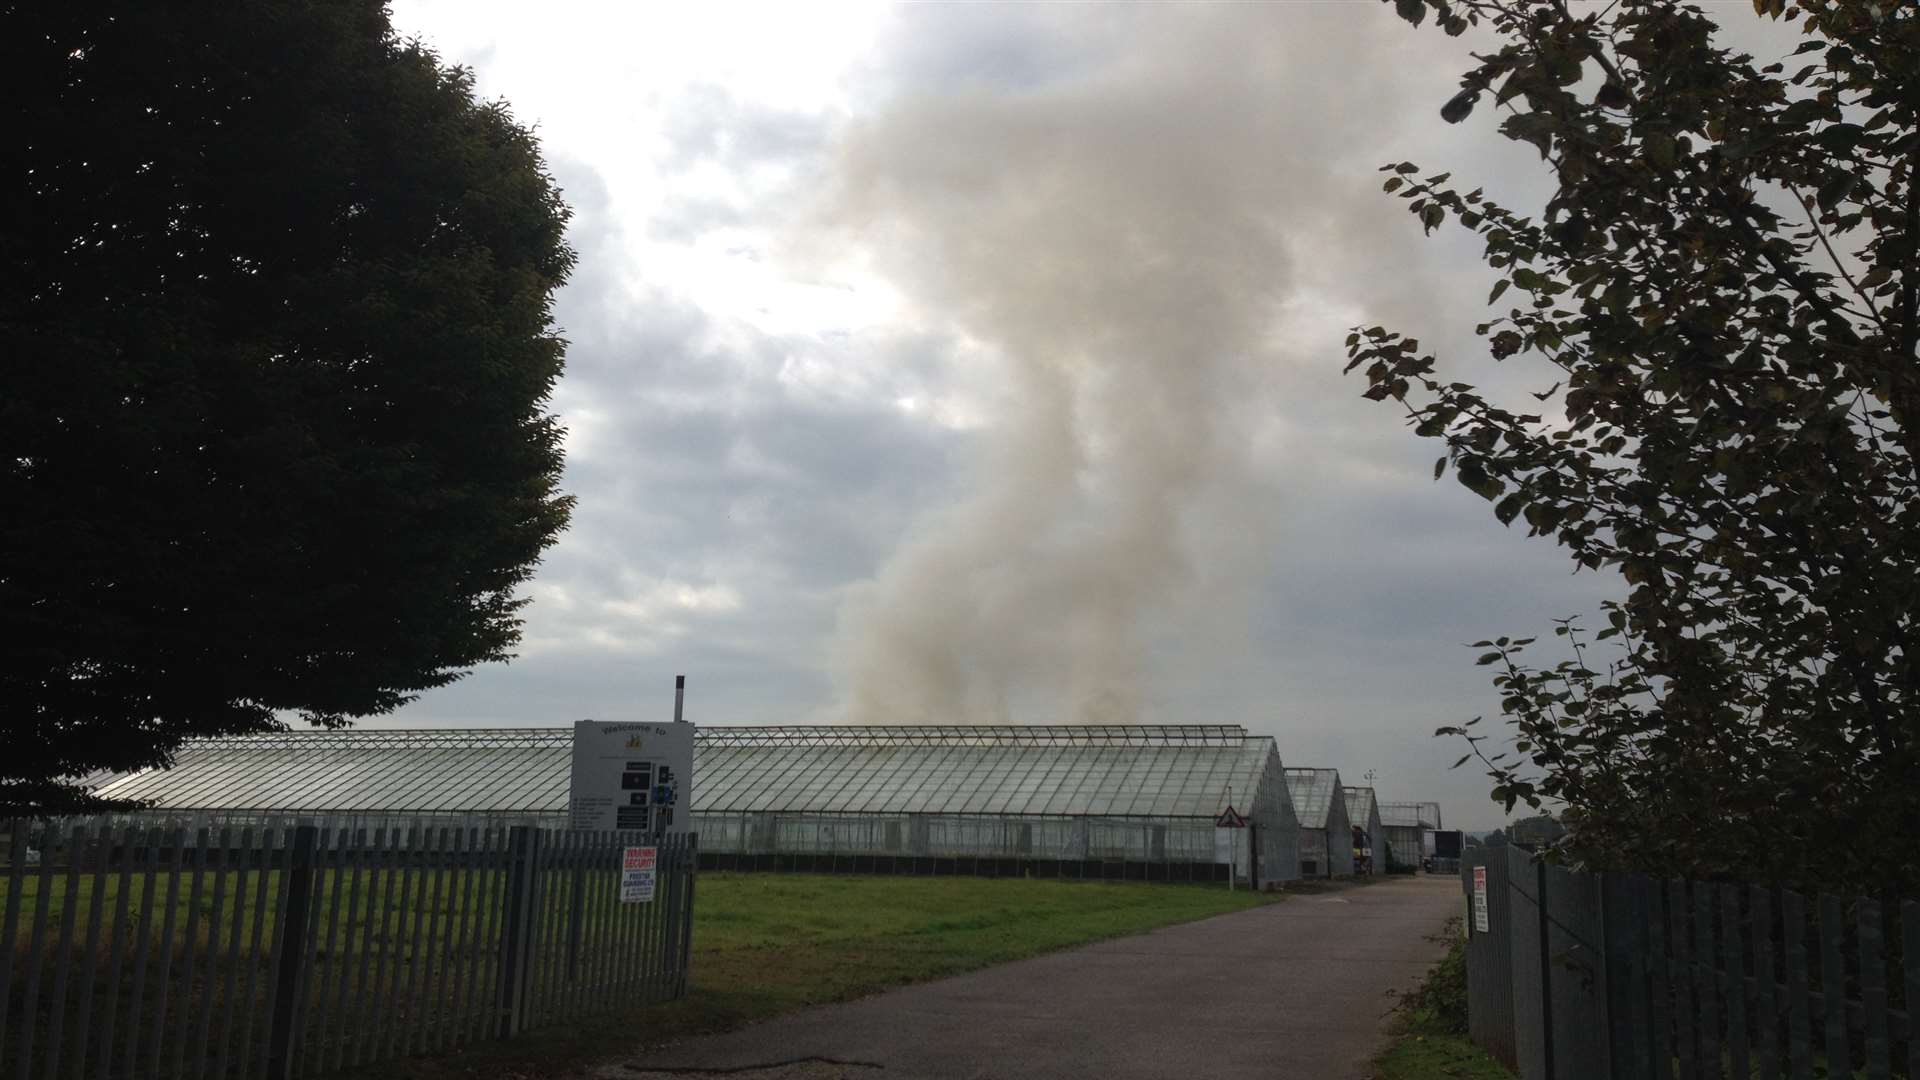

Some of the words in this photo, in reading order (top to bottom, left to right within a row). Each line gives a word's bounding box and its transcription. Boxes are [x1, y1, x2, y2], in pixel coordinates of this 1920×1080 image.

[601, 724, 650, 735] Welcome
[655, 727, 666, 736] to
[626, 848, 656, 857] WARNING
[625, 858, 655, 868] SECURITY
